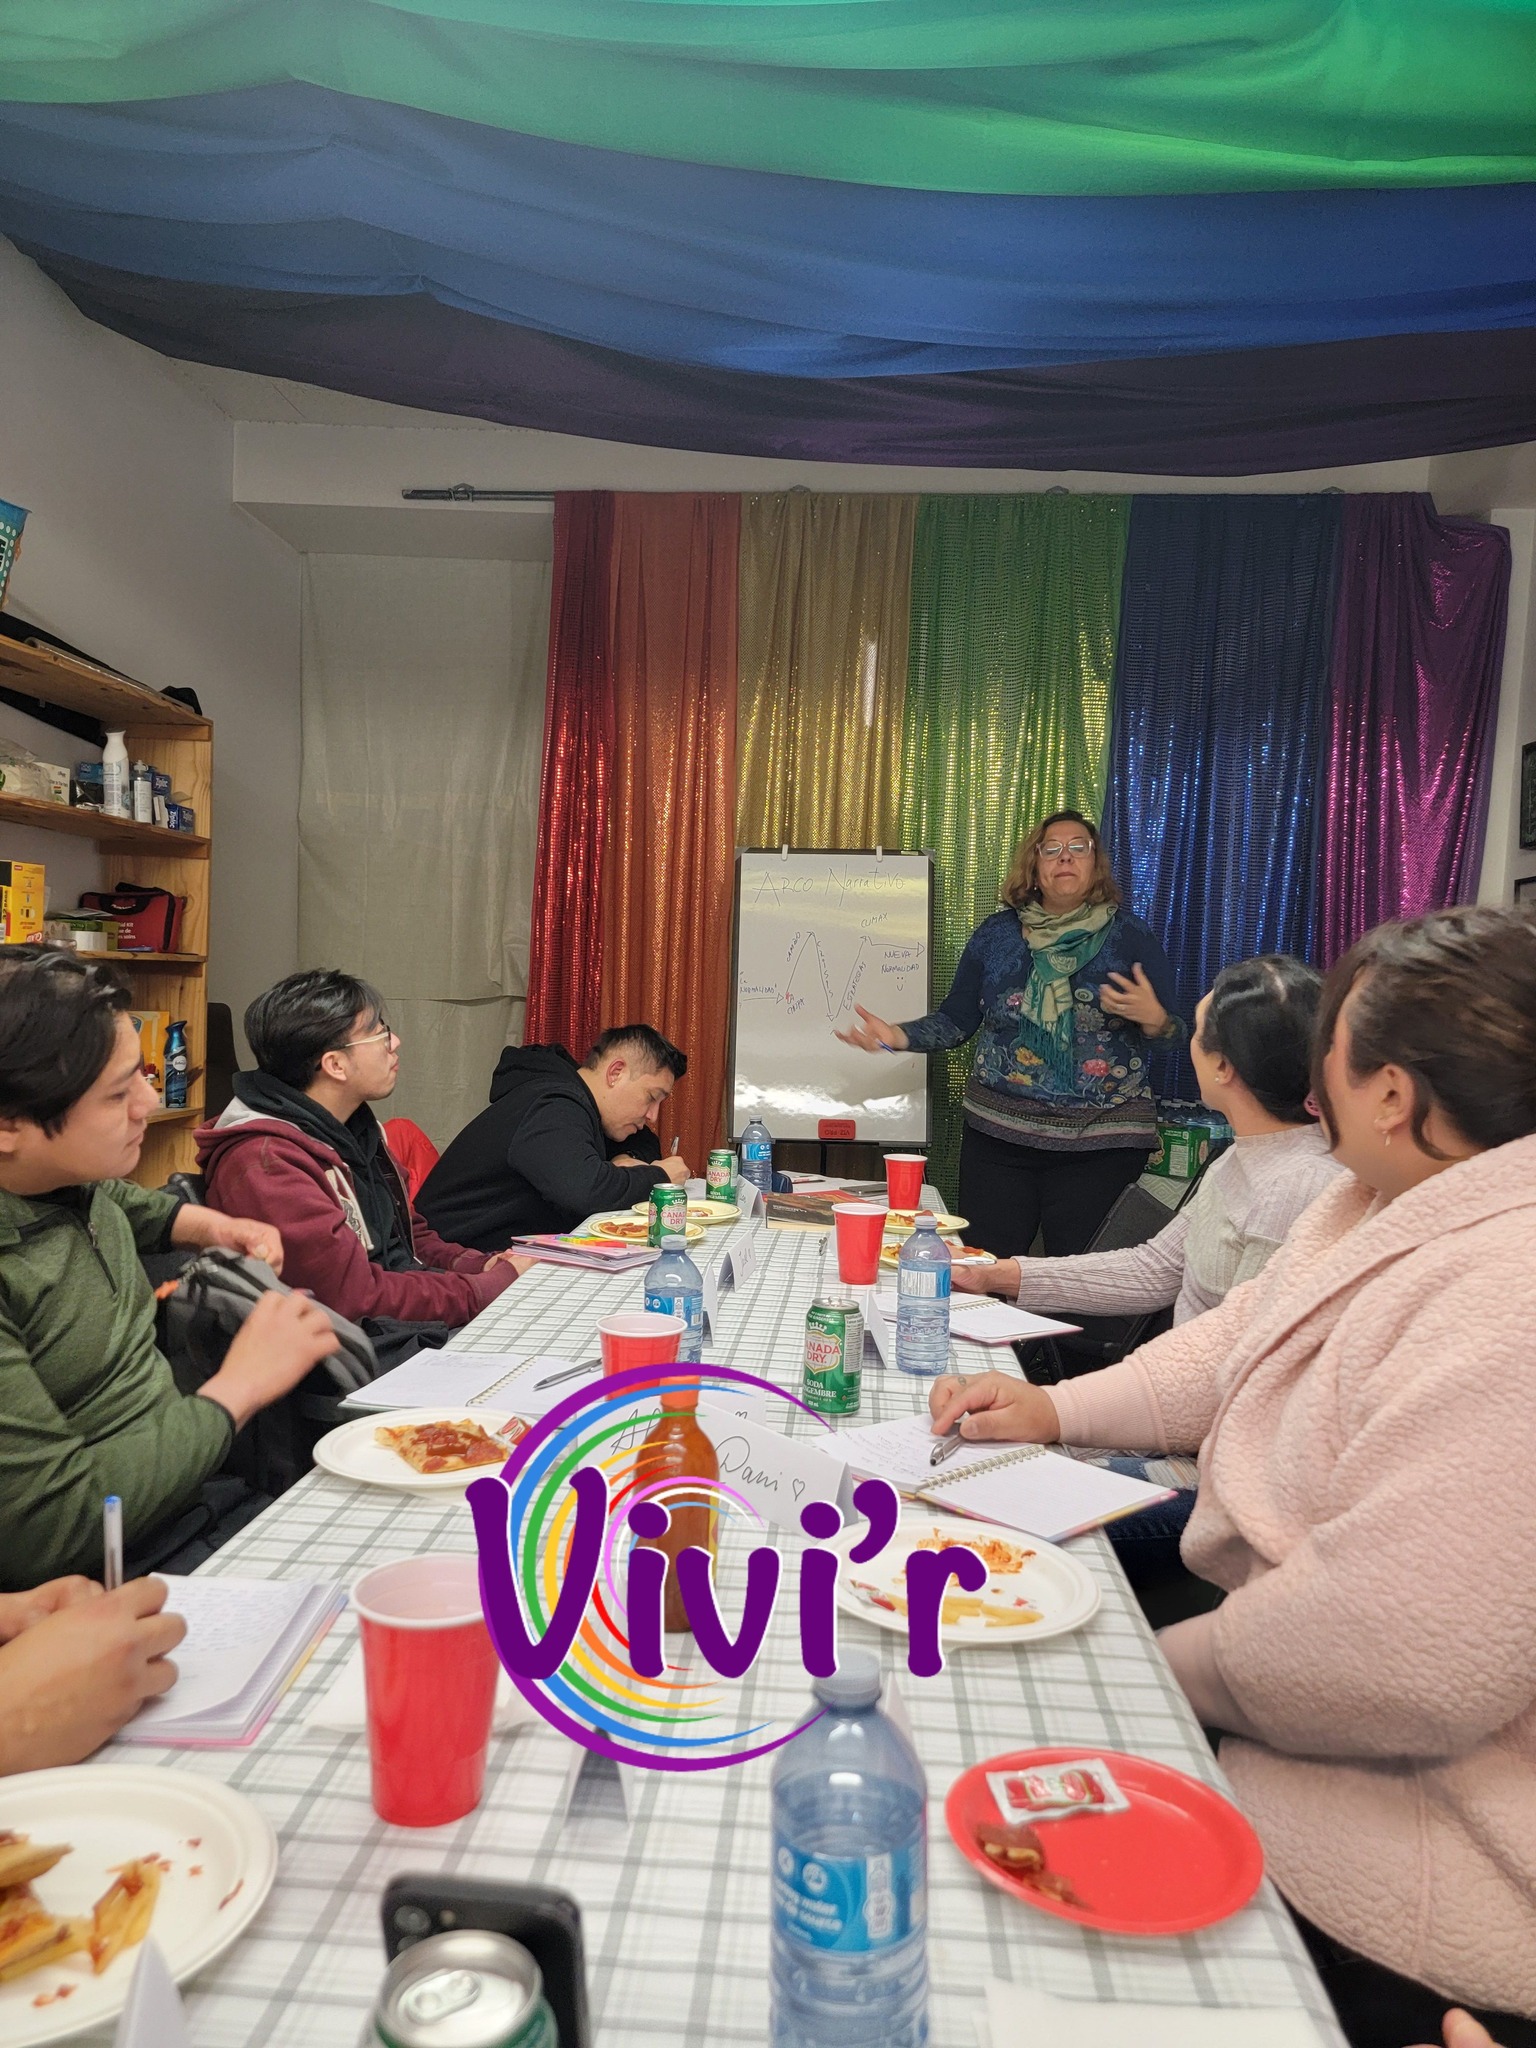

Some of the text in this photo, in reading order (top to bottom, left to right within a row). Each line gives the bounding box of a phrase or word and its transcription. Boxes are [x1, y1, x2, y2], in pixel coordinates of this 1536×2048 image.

[752, 871, 814, 907] ARCO
[884, 950, 911, 959] NUEVA
[806, 1378, 824, 1389] SODA
[715, 1436, 779, 1492] Dani
